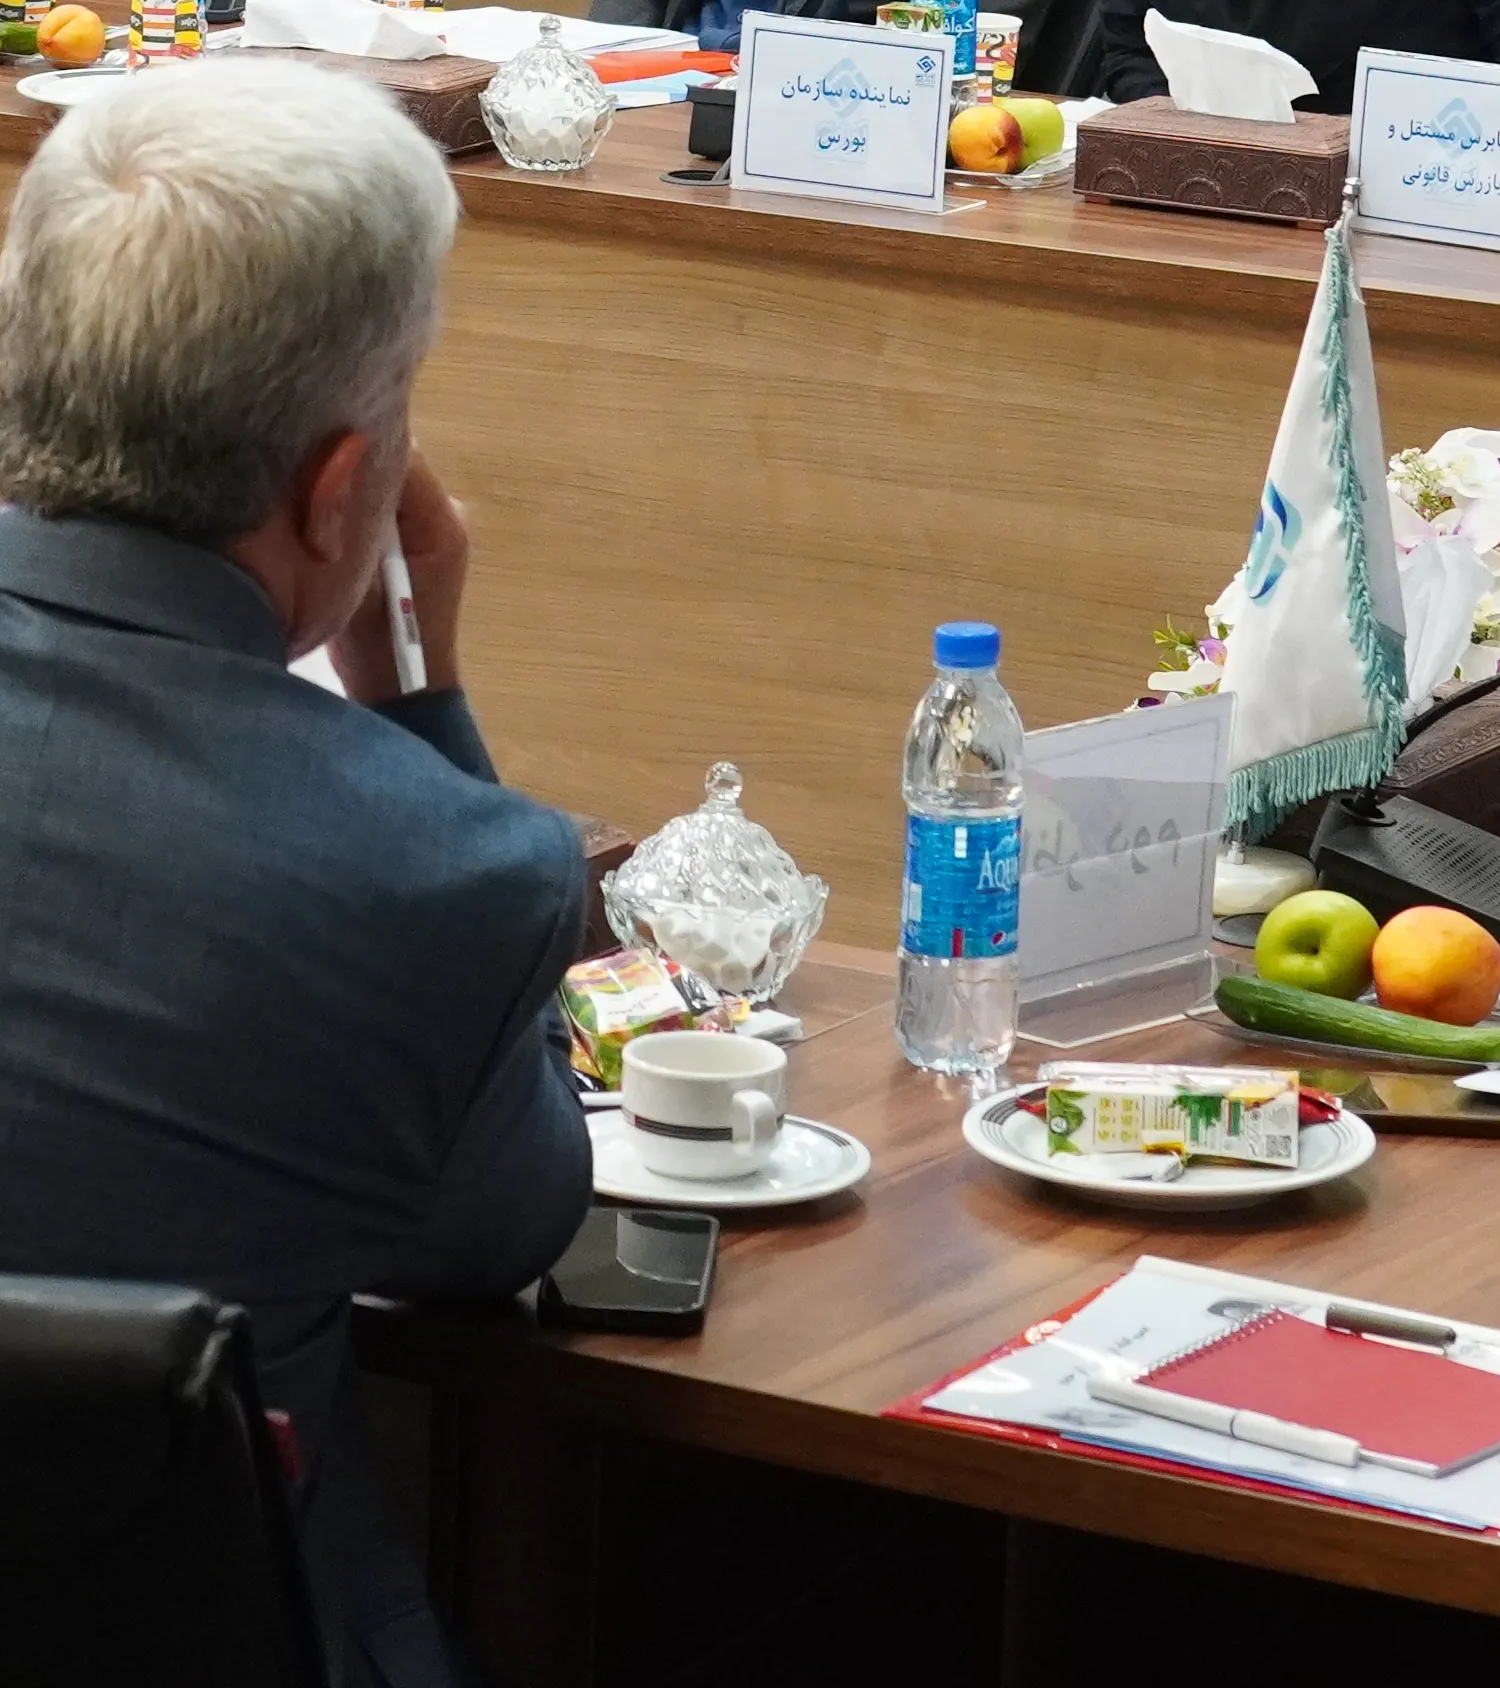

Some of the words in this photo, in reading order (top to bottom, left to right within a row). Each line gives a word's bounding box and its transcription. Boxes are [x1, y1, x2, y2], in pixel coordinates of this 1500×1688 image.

[781, 74, 843, 102] سازمان
[849, 86, 911, 109] نماینده
[1387, 123, 1396, 140] و
[1400, 119, 1456, 143] مستقل
[818, 133, 867, 153] بورس
[1402, 164, 1450, 188] قانونی
